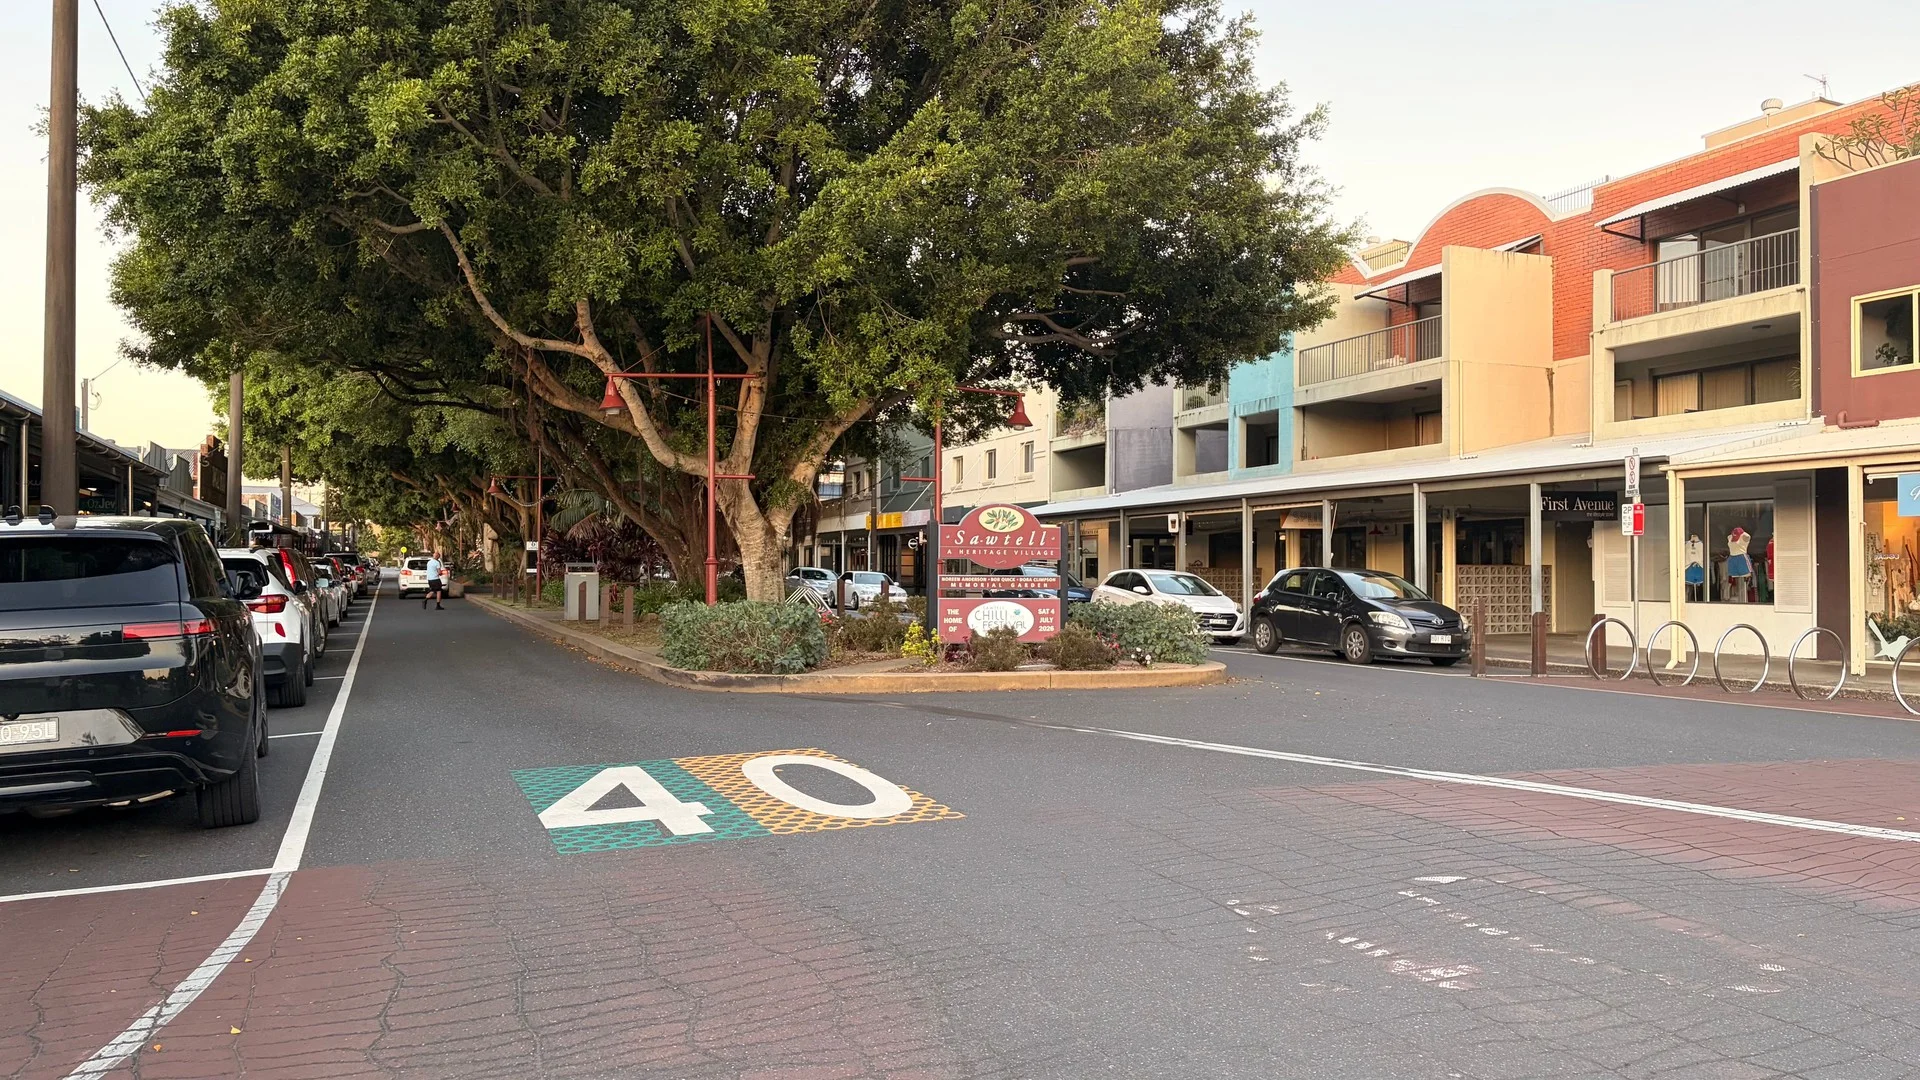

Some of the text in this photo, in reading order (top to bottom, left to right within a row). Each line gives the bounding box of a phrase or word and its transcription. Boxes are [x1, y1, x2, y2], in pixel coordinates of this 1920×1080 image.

[1540, 496, 1614, 511] First Avenue
[1623, 506, 1632, 514] 2P
[954, 530, 1047, 546] Sawtell
[974, 610, 1008, 621] CHILLI
[537, 754, 915, 836] 40
